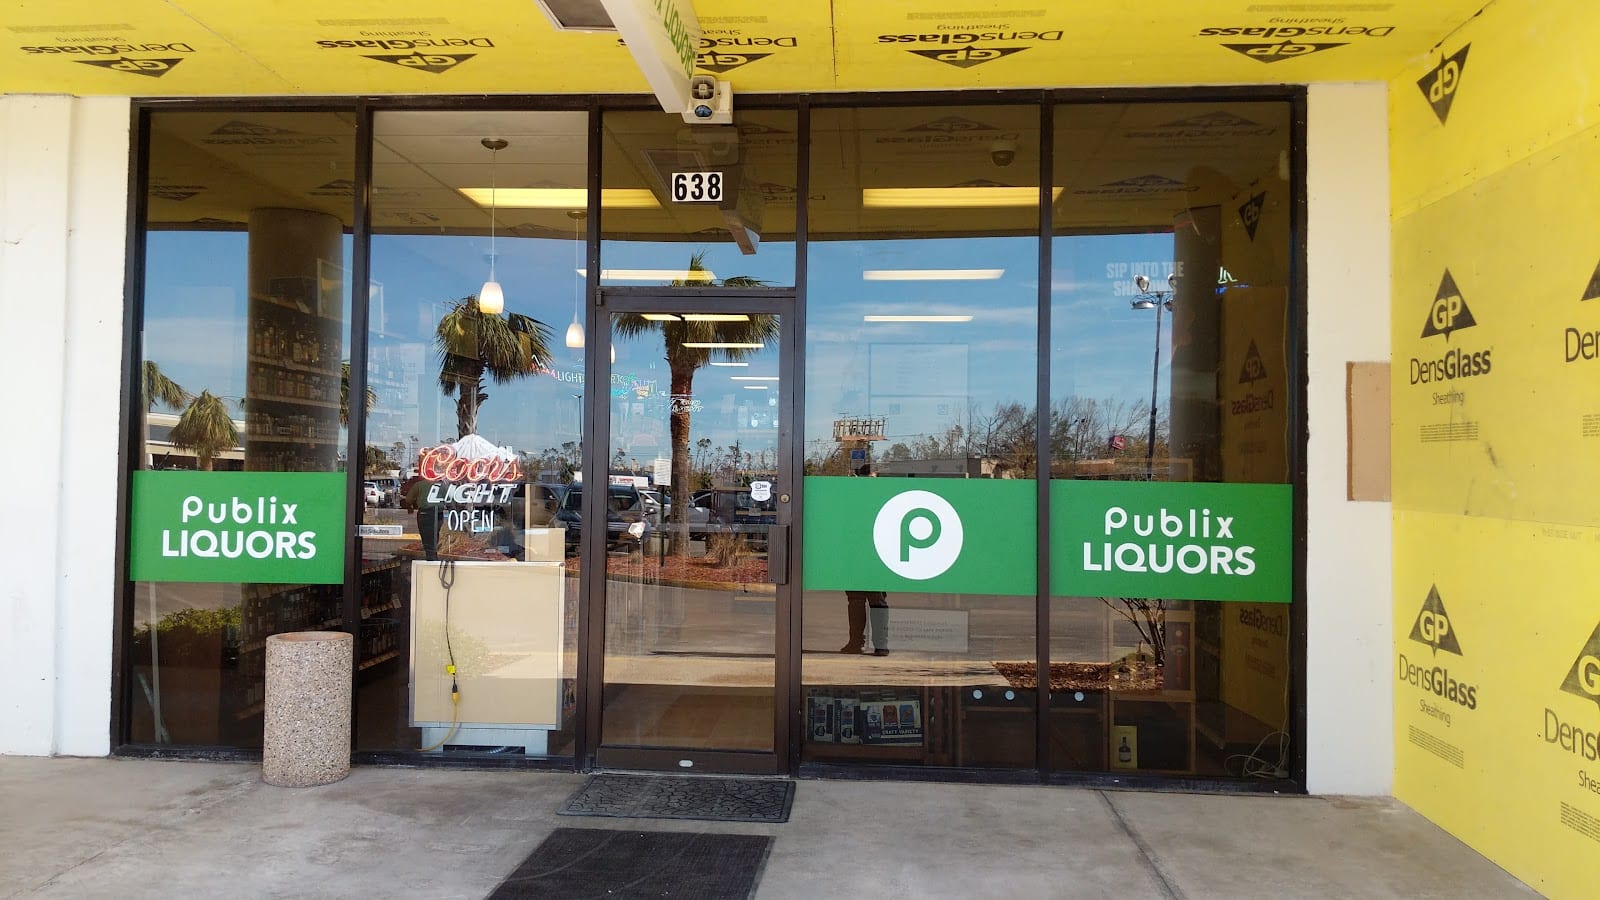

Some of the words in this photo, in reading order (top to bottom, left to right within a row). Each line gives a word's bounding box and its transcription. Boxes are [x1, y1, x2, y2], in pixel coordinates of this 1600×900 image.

[315, 38, 495, 50] DensGlass
[877, 30, 1064, 44] DensGlass
[1199, 26, 1396, 38] DensGlass
[20, 43, 197, 55] DensGlass
[1429, 60, 1459, 104] GP
[674, 173, 721, 200] 638
[1106, 262, 1127, 278] SIP
[1130, 262, 1158, 277] INTO
[1161, 261, 1185, 276] THE
[1432, 295, 1462, 330] GP
[1410, 348, 1491, 386] DensGlass
[419, 444, 523, 482] Coors
[426, 483, 518, 504] LIGHT
[182, 495, 298, 525] Publix
[447, 509, 494, 533] OPEN
[1104, 506, 1234, 538] Publix
[162, 529, 317, 560] LIQUORS
[1083, 542, 1256, 576] LIQUORS
[1419, 610, 1449, 644] GP
[1399, 653, 1477, 710] DensGlass
[1577, 655, 1600, 696] G
[1419, 698, 1451, 728] Sheathing
